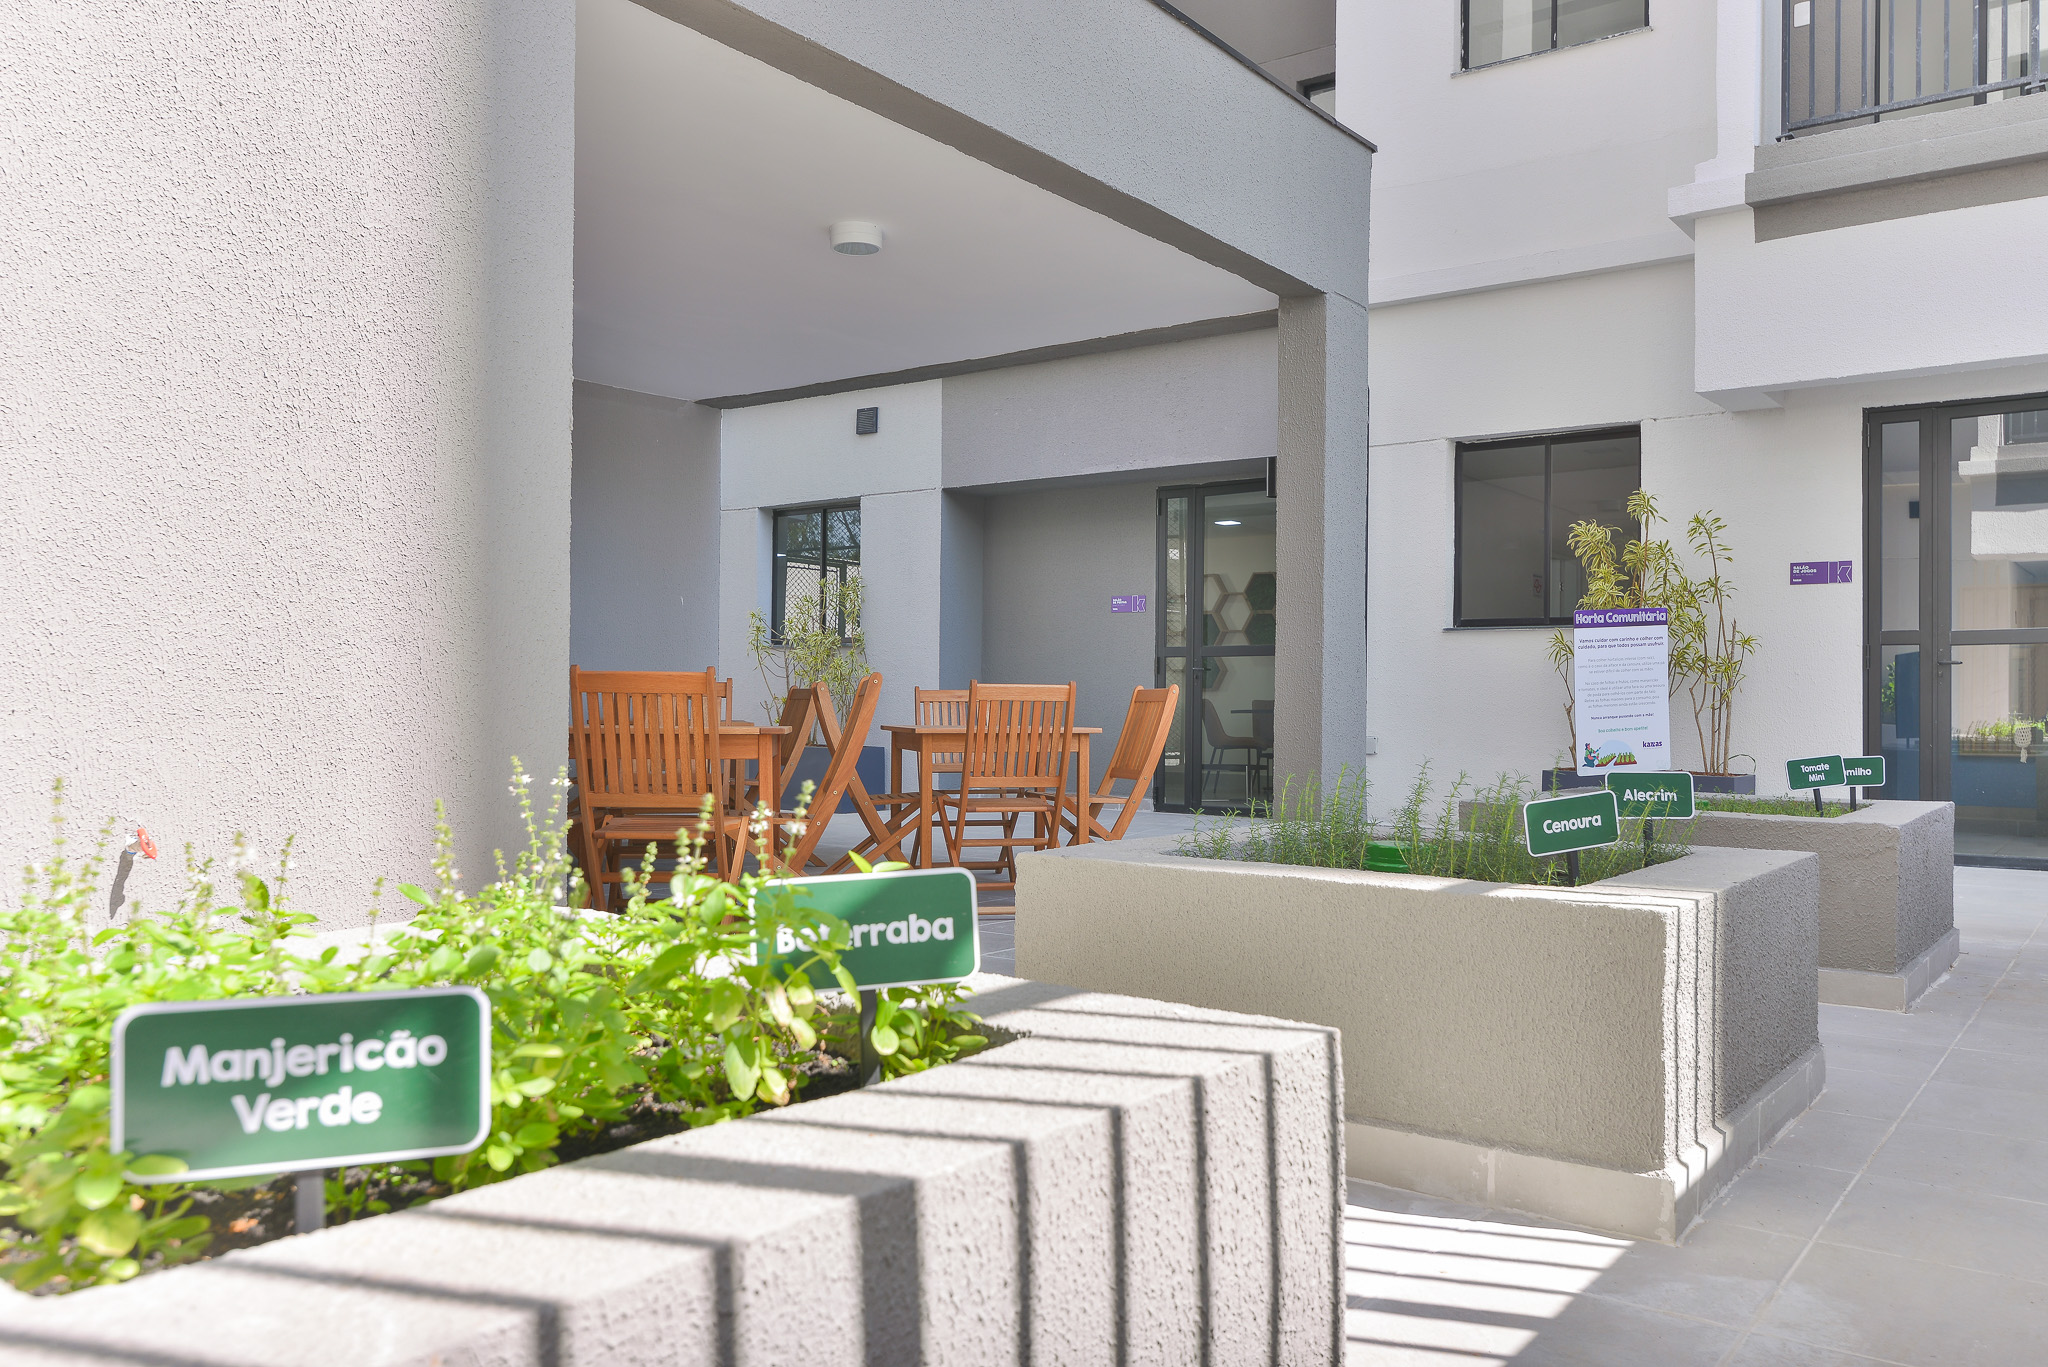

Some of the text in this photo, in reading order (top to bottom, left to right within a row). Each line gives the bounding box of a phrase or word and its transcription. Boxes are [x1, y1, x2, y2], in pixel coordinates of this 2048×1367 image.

[1576, 611, 1666, 624] Horta Comunitária
[1800, 763, 1829, 773] Tomate
[1845, 768, 1872, 776] milho
[1808, 773, 1825, 782] Mini
[1623, 788, 1677, 801] Alecrim
[1543, 815, 1602, 834] Cenoura
[776, 913, 955, 954] Betrraba
[160, 1029, 448, 1088] Manjericão
[231, 1086, 383, 1134] Verde
